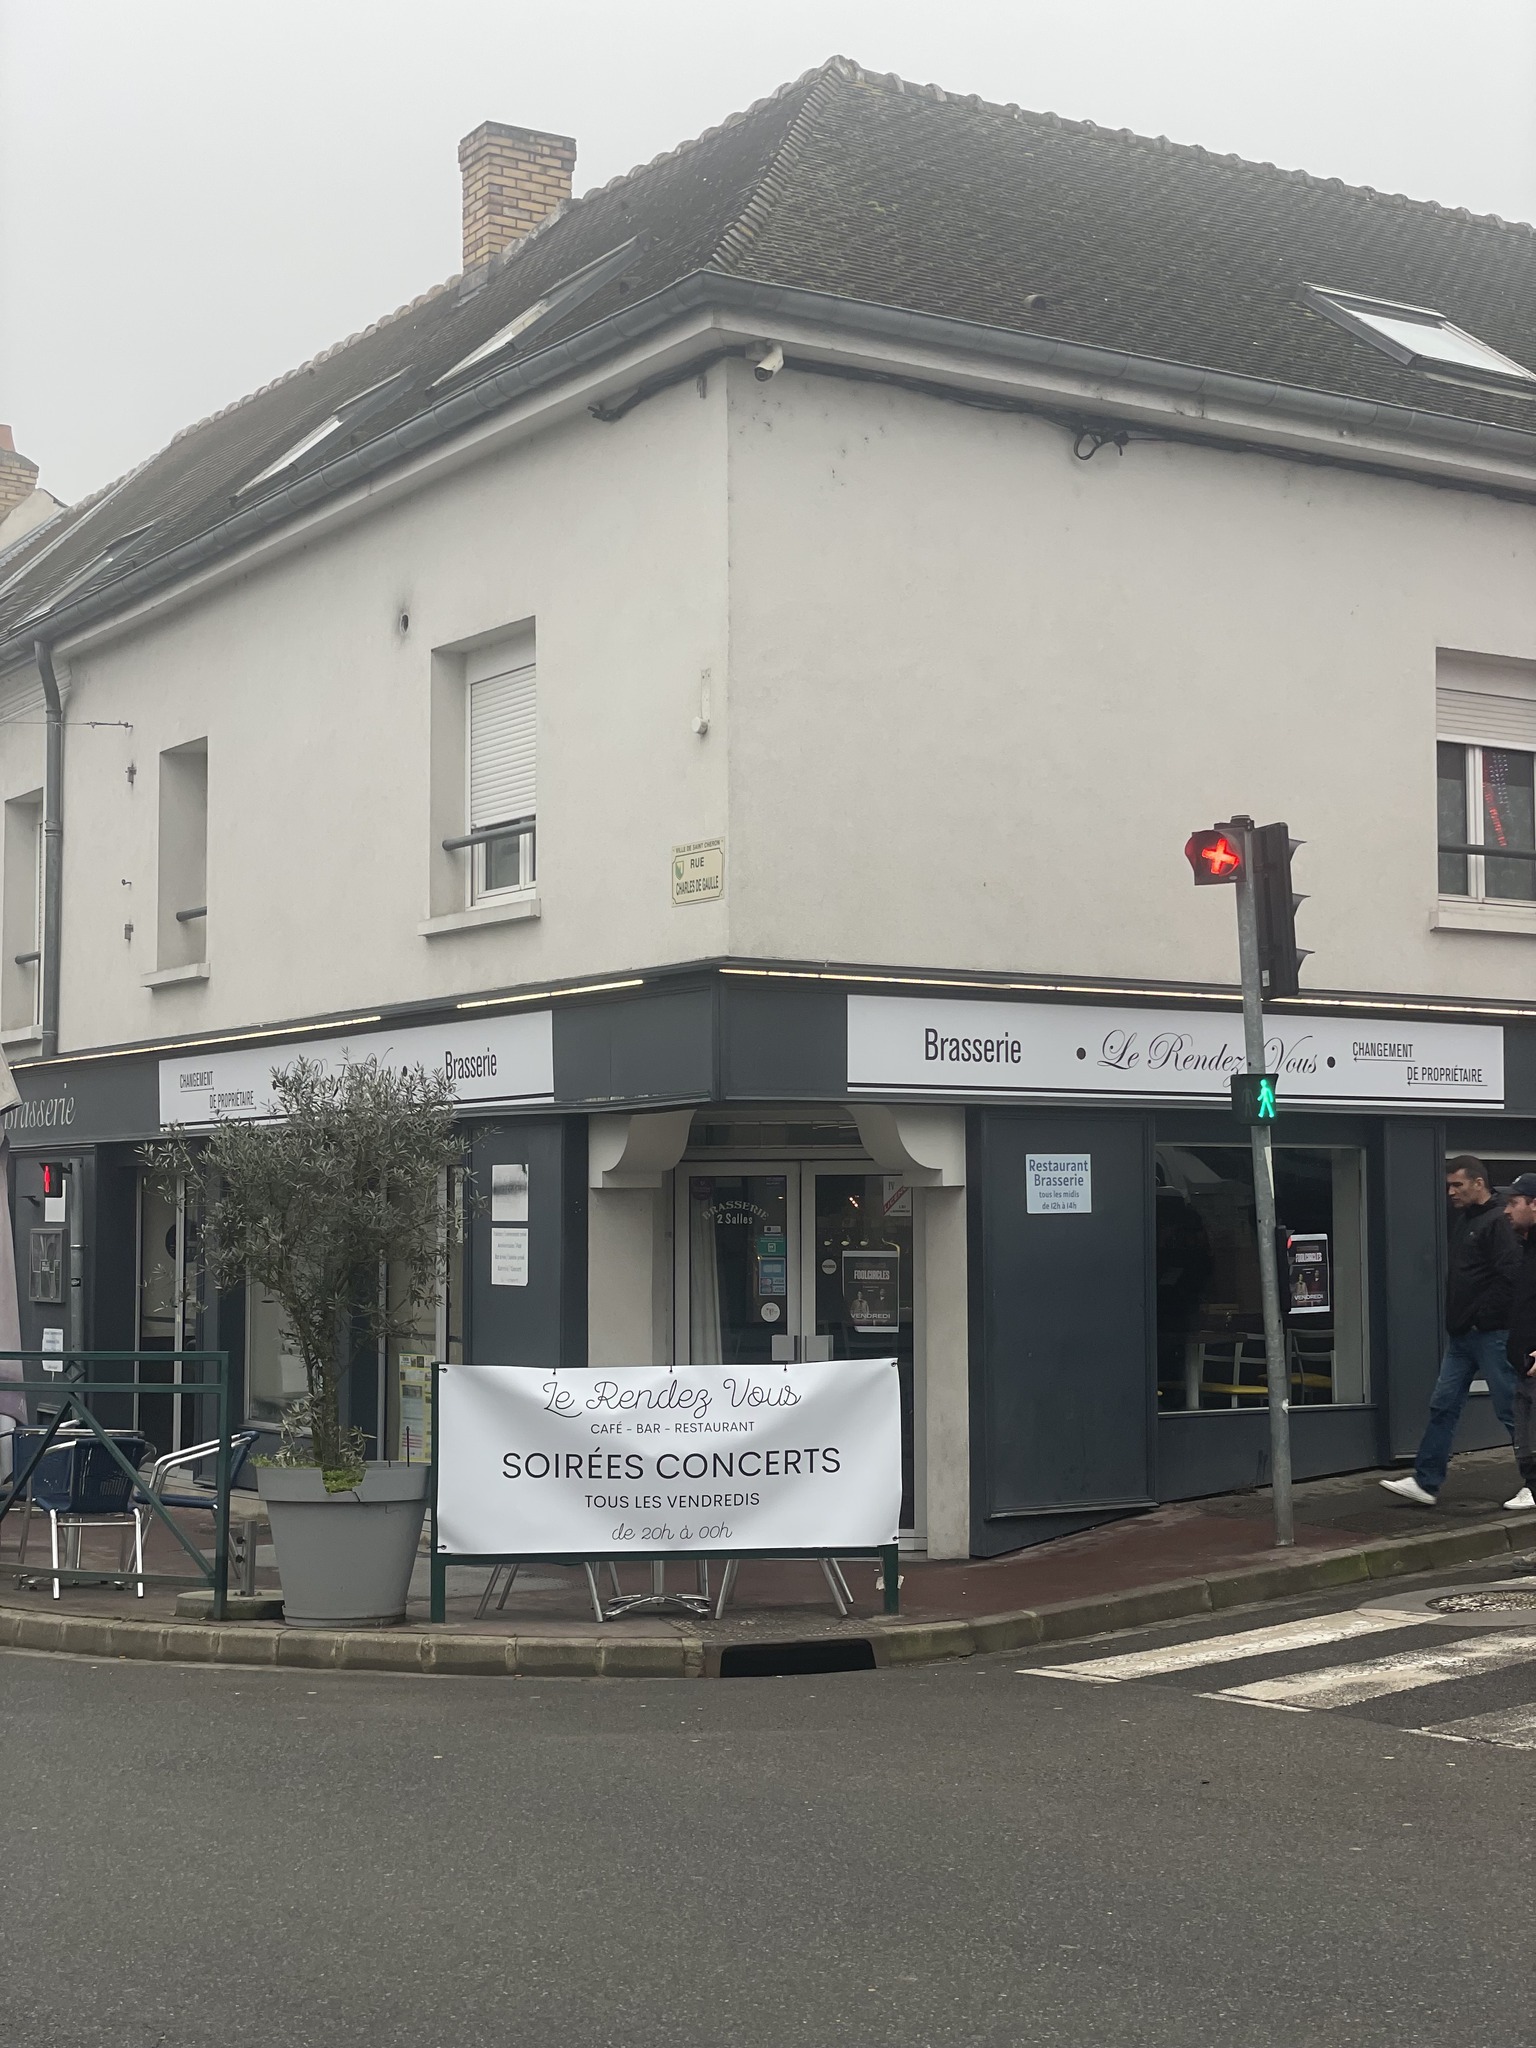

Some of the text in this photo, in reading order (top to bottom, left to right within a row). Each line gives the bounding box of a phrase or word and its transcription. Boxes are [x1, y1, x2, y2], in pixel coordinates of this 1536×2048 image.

[704, 840, 720, 848] CHERON
[690, 857, 704, 869] RUE
[676, 875, 719, 896] CHARLES DE GAULLE
[923, 1028, 1022, 1065] Brasserie
[1352, 1041, 1414, 1058] CHANGEMENT
[445, 1047, 497, 1080] Brasserie
[1096, 1028, 1318, 1088] Le Rendez Vous
[179, 1070, 214, 1088] CHANGEMENT
[1406, 1064, 1483, 1083] DE PROPRIÉTAIRE
[209, 1089, 254, 1109] DE PROPRIÉTAIRE
[1028, 1159, 1089, 1172] Restaurant
[1034, 1173, 1084, 1187] Brasserie
[1053, 1190, 1062, 1198] les
[1062, 1190, 1080, 1198] midis
[702, 1200, 770, 1221] BRASSERIE
[1041, 1201, 1077, 1210] de 12h à 14h
[716, 1212, 753, 1225] 2 Salles
[853, 1269, 890, 1280] FOOLCIRCLES
[542, 1378, 802, 1419] Le Rendez Vous
[590, 1421, 623, 1435] CAFÉ
[636, 1422, 661, 1434] BAR
[675, 1421, 755, 1434] RESTAURANT
[502, 1446, 841, 1480] SOIRÉES CONCERTS
[585, 1492, 760, 1509] TOUS LES VENDREDIS
[611, 1523, 635, 1541] de
[641, 1523, 675, 1541] 20h
[679, 1524, 693, 1540] à
